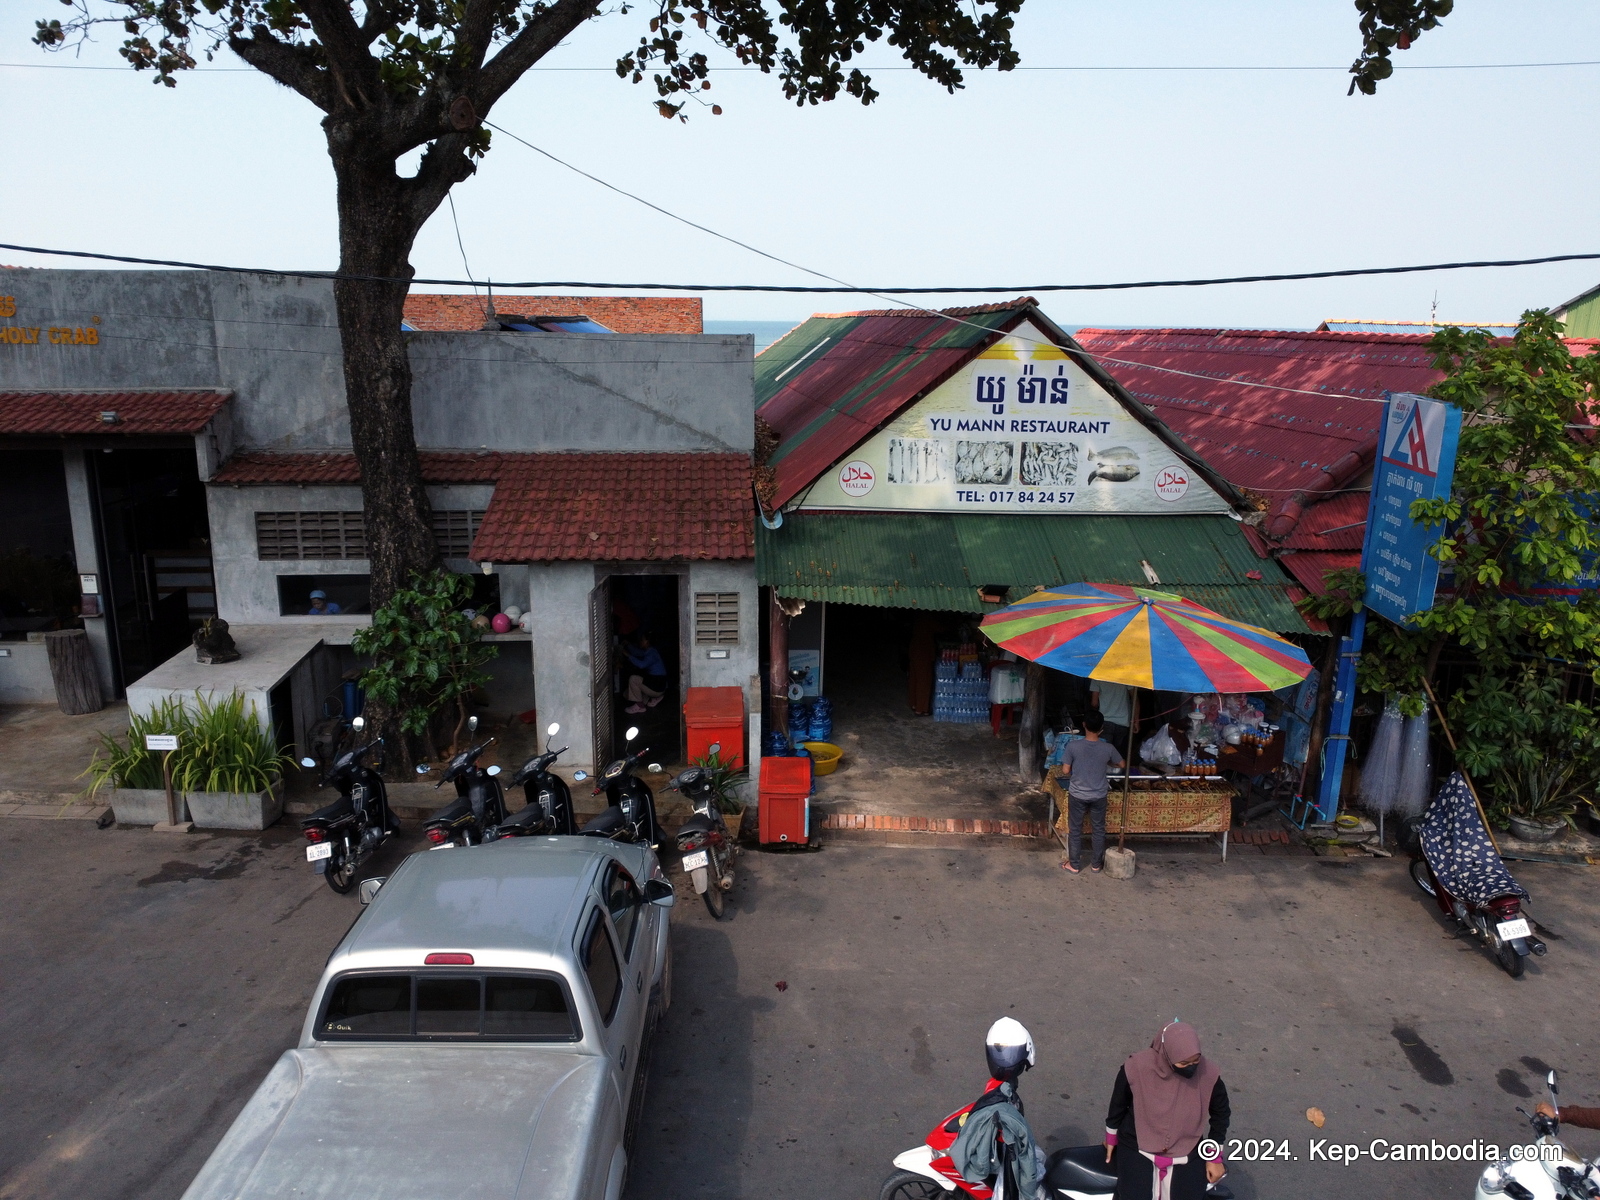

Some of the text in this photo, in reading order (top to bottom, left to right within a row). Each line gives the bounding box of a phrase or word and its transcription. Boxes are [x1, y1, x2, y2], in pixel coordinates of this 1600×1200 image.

[48, 327, 99, 344] CRAB
[977, 364, 1069, 415] យូ ម៉ាន់
[931, 419, 1111, 434] YU MANN RESTAURANT
[842, 466, 873, 482] حلال
[1157, 471, 1187, 487] حلال
[957, 490, 1075, 504] TEL: 017 84 24 57
